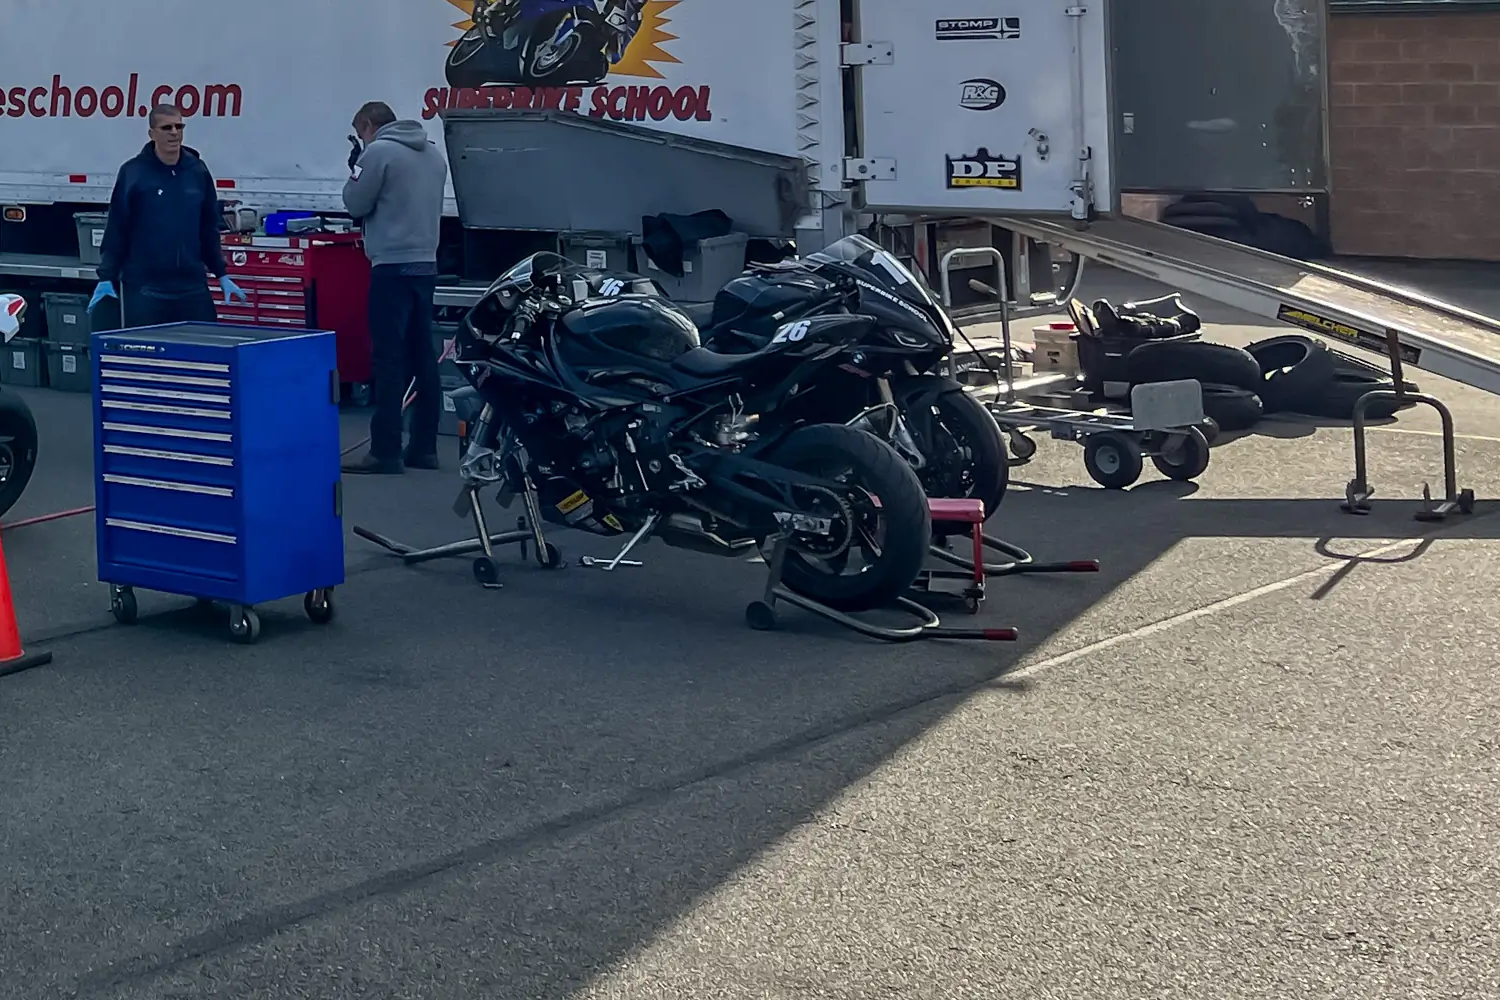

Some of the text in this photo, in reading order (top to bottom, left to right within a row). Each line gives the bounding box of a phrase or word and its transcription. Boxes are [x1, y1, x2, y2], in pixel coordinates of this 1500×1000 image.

[938, 20, 994, 29] STOMP
[964, 85, 999, 99] R&G
[589, 84, 712, 122] SCHOOL
[951, 161, 1017, 178] DP
[599, 277, 625, 297] 16
[855, 279, 928, 323] SUPERBIKE SCHOOL
[772, 319, 812, 344] 26
